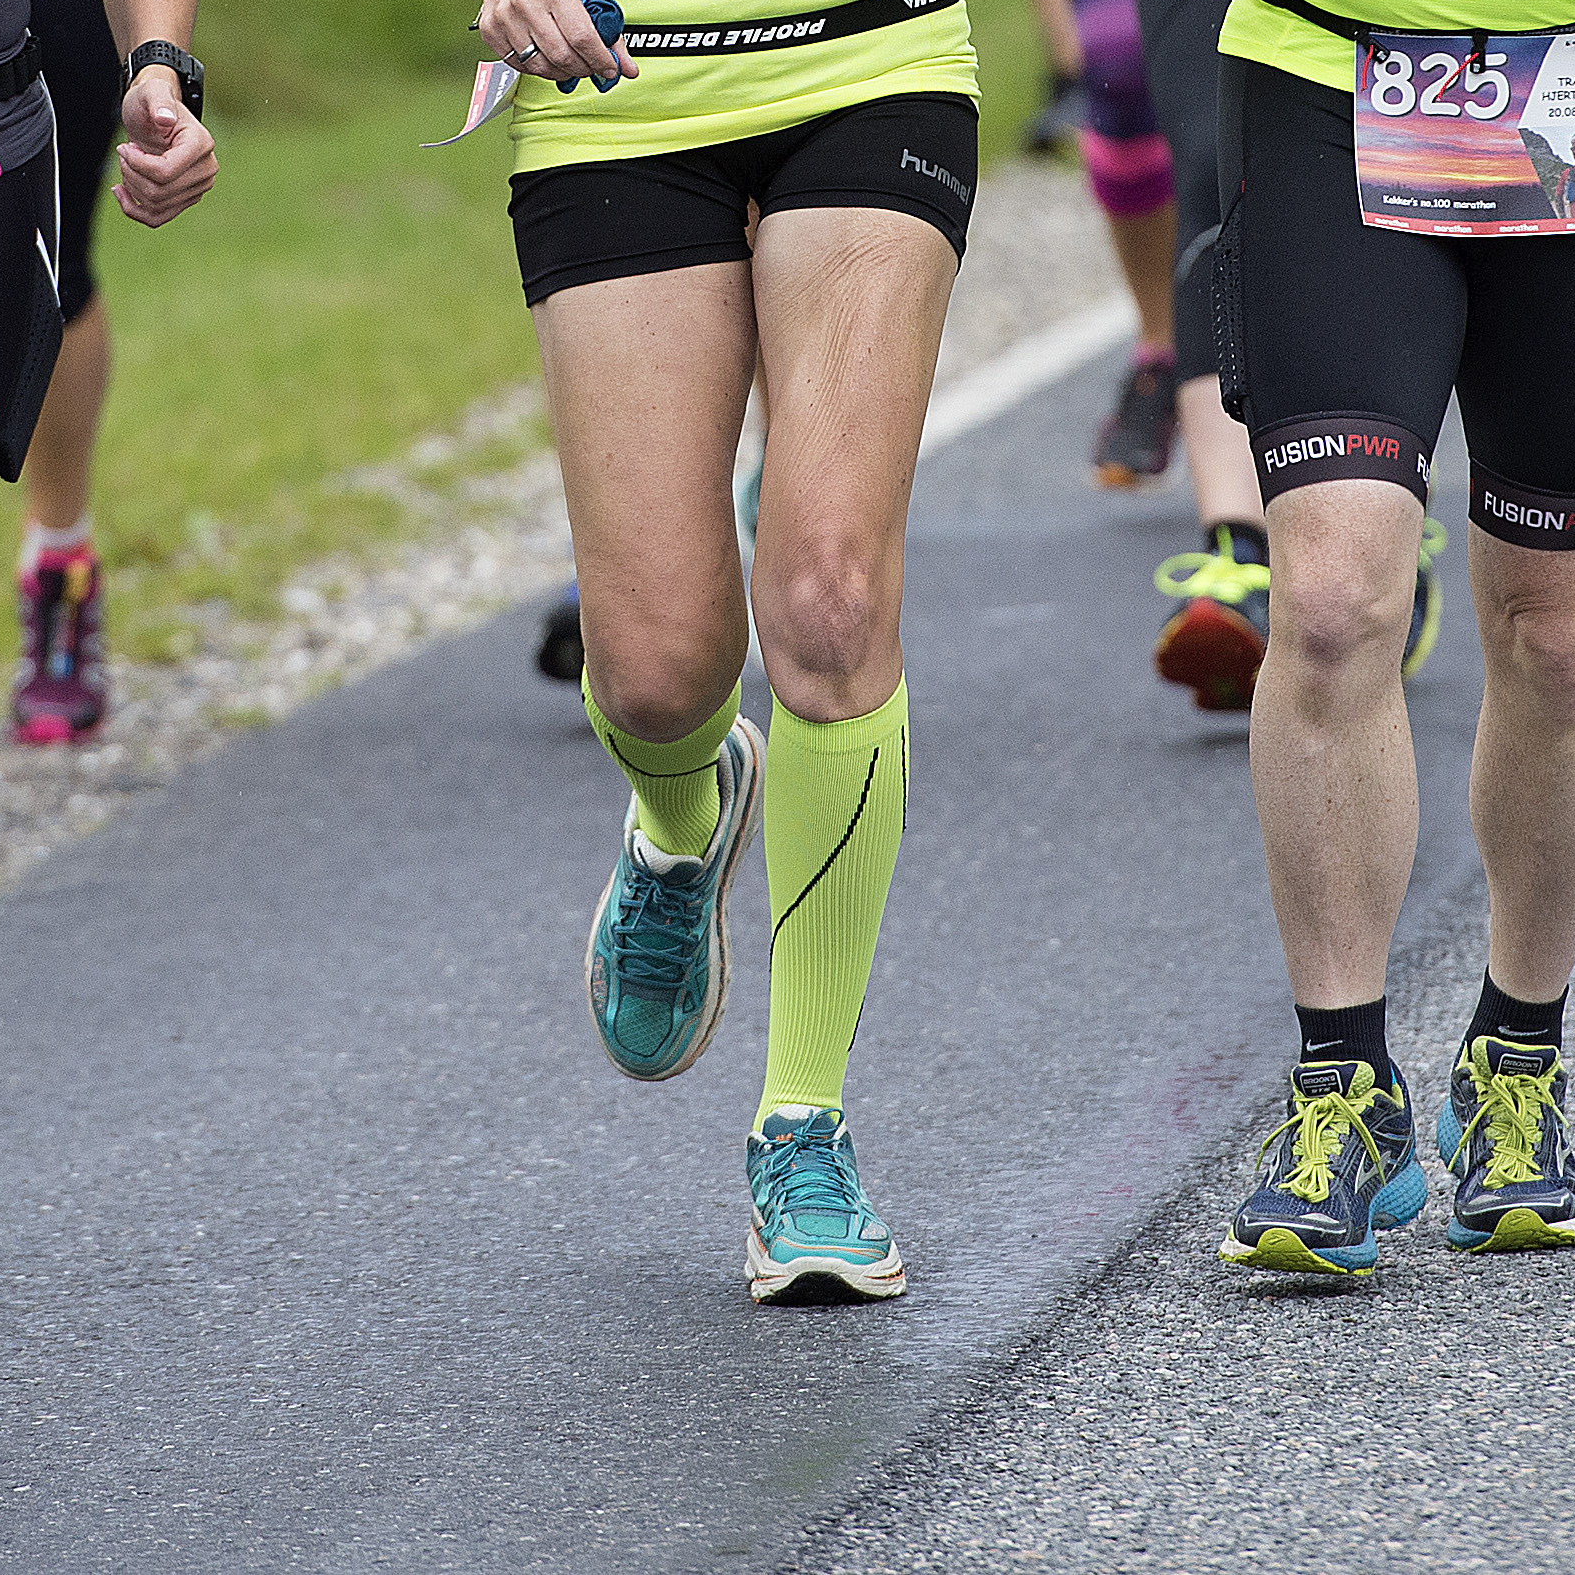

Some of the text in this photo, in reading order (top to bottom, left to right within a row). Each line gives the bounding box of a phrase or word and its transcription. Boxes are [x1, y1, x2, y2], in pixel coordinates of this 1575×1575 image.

[629, 18, 826, 48] PROFILE DESIGN
[1370, 50, 1511, 120] 825
[900, 148, 971, 205] hummel
[1453, 200, 1496, 209] marathon
[1264, 434, 1401, 474] FUSIONPWR
